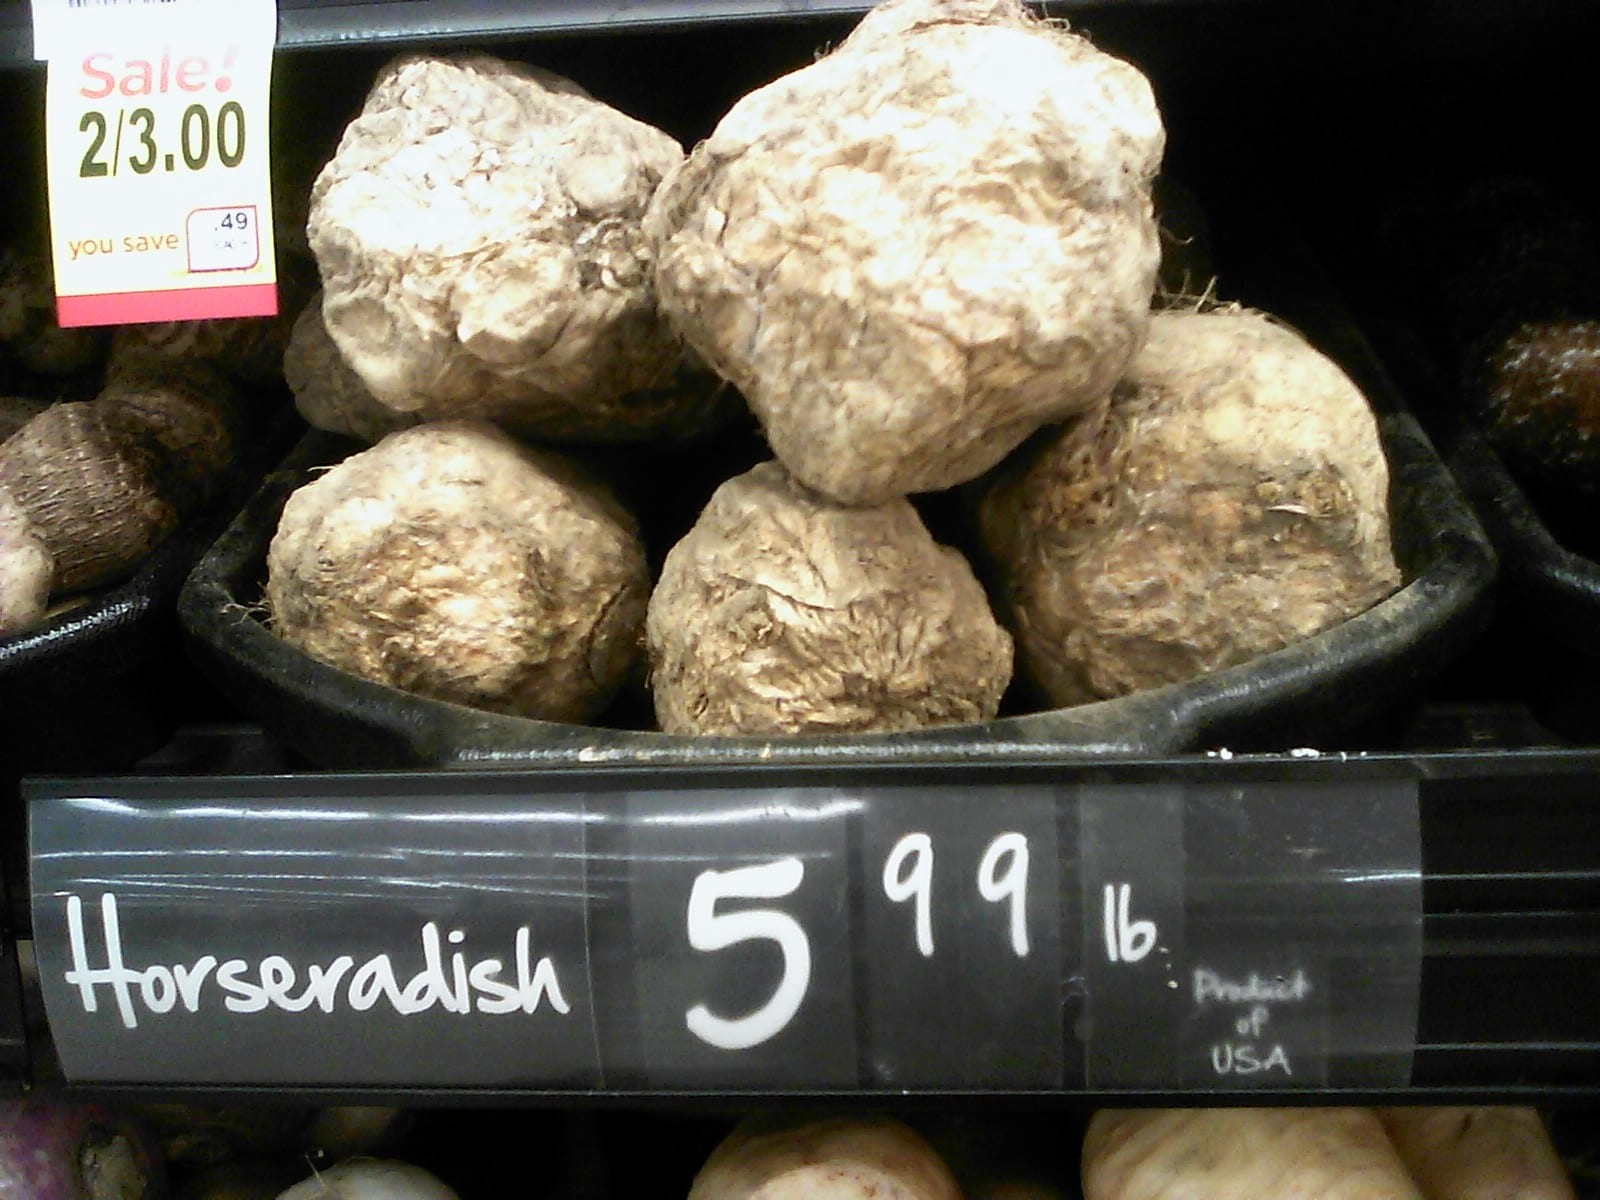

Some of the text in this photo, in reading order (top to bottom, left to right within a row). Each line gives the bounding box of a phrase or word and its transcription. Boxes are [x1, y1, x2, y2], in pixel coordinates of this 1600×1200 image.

[79, 46, 239, 99] Sale!
[78, 101, 247, 177] 2/3.00
[68, 233, 180, 261] you save
[65, 892, 570, 1030] Horseradish
[686, 856, 811, 1050] 5
[1212, 1044, 1292, 1076] USA
